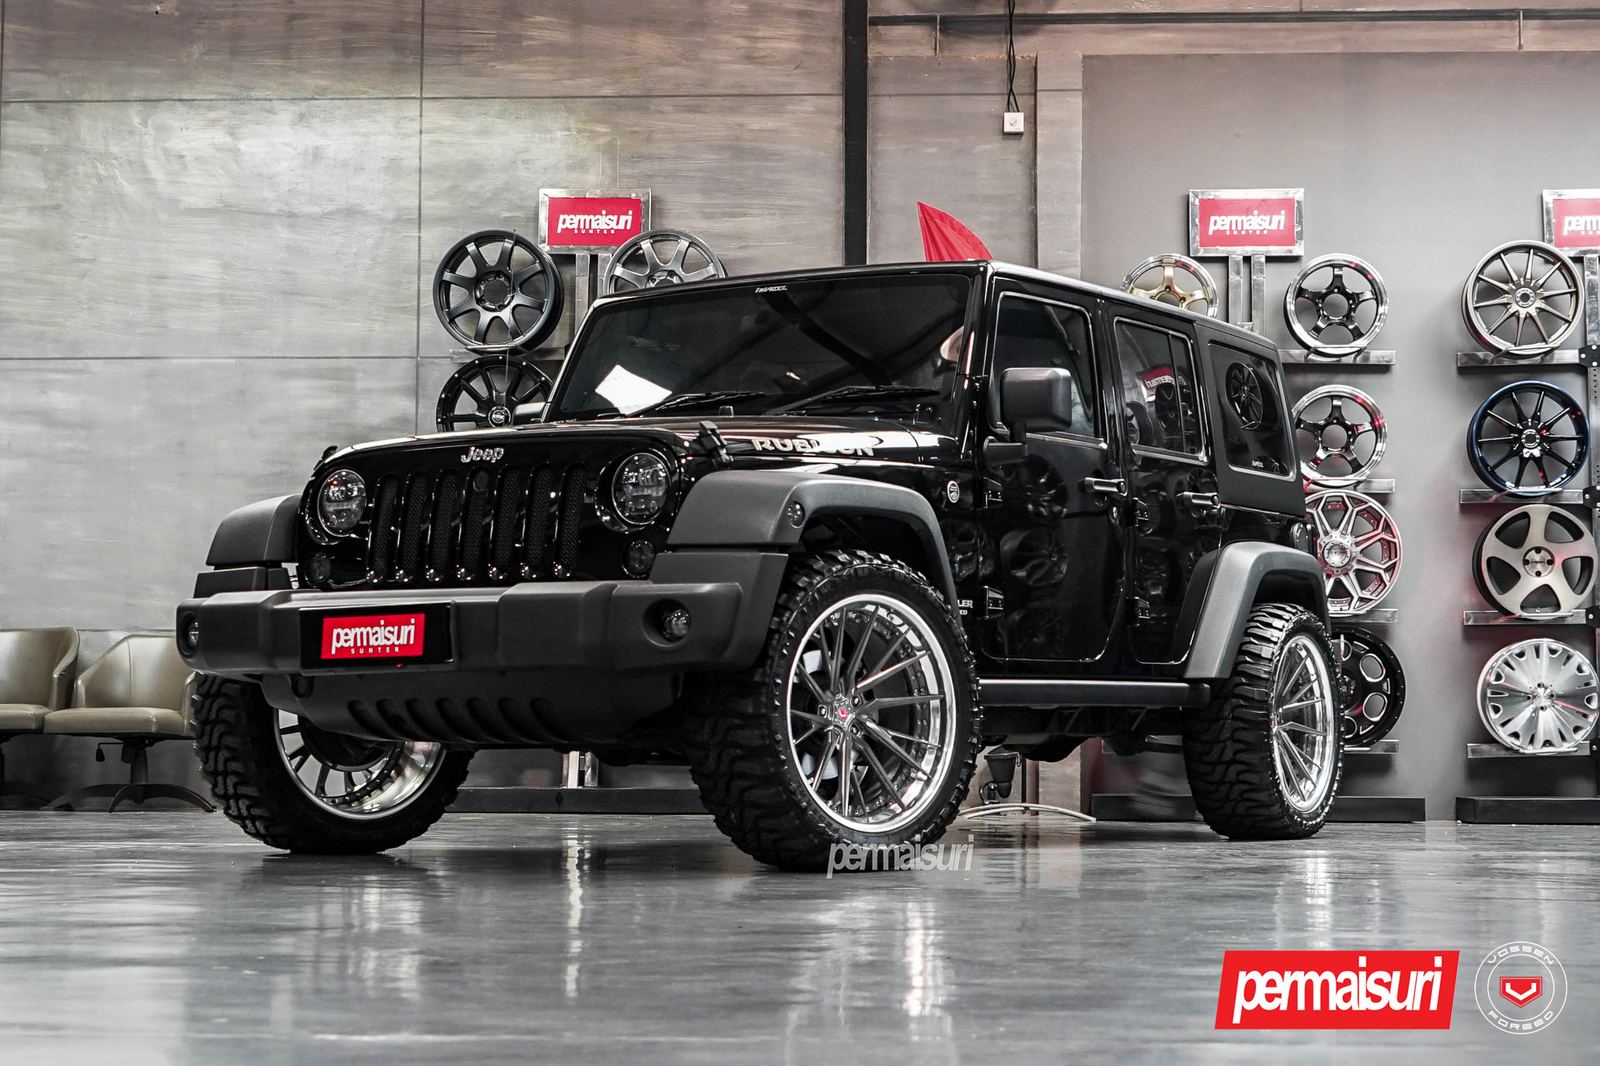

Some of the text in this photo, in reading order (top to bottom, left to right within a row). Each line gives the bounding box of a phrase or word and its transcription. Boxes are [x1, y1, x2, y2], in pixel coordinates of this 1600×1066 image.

[557, 210, 633, 233] permaisuri
[1208, 210, 1286, 235] permaisuri
[461, 446, 505, 463] Jeep
[331, 618, 415, 655] permaisuri
[351, 646, 400, 654] SUNTER
